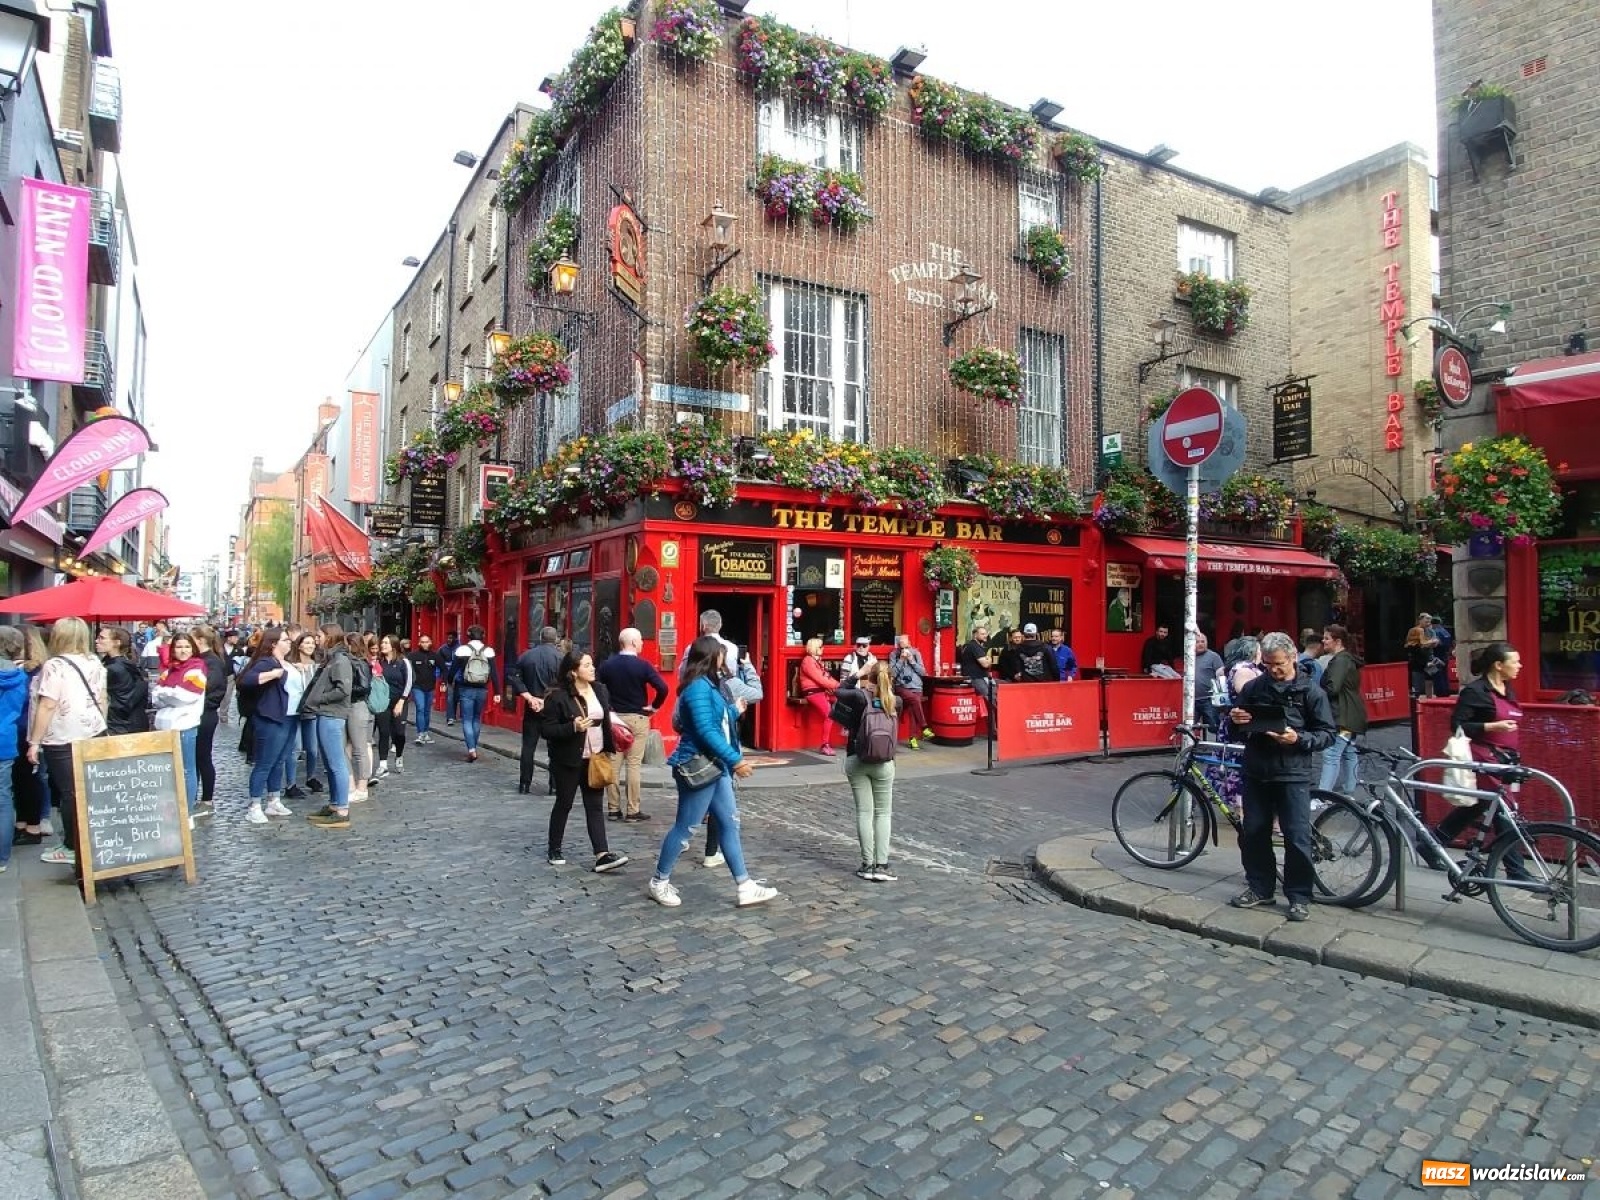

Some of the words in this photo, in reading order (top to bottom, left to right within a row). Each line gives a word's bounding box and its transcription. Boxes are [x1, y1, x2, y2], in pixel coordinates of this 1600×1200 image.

[34, 189, 77, 256] NINE
[1382, 191, 1399, 247] THE
[929, 242, 962, 265] THE
[30, 264, 71, 353] CLOUD
[1381, 263, 1402, 375] TEMPLE
[1385, 394, 1403, 449] BAR
[53, 450, 102, 481] CLOUD
[101, 426, 136, 453] NINE
[772, 508, 833, 530] THE
[844, 514, 945, 537] TEMPLE
[956, 522, 1003, 541] BAR
[711, 554, 766, 575] TOBACCO
[1207, 562, 1223, 571] THE
[1224, 562, 1255, 573] TEMPLE
[1256, 565, 1271, 574] BAR
[979, 579, 1018, 589] TEMPLE
[991, 590, 1010, 600] BAR
[1048, 589, 1064, 601] THE
[1054, 616, 1064, 628] OF
[1025, 719, 1055, 728] TEMPLE
[1056, 718, 1072, 726] BAR
[1133, 712, 1162, 721] TEMPLE
[1163, 711, 1178, 719] BAR
[88, 765, 127, 779] Mexico
[137, 760, 171, 773] Rome
[92, 781, 126, 793] Lunch
[131, 776, 162, 789] Deal
[94, 831, 124, 849] Early
[131, 822, 161, 842] Bird
